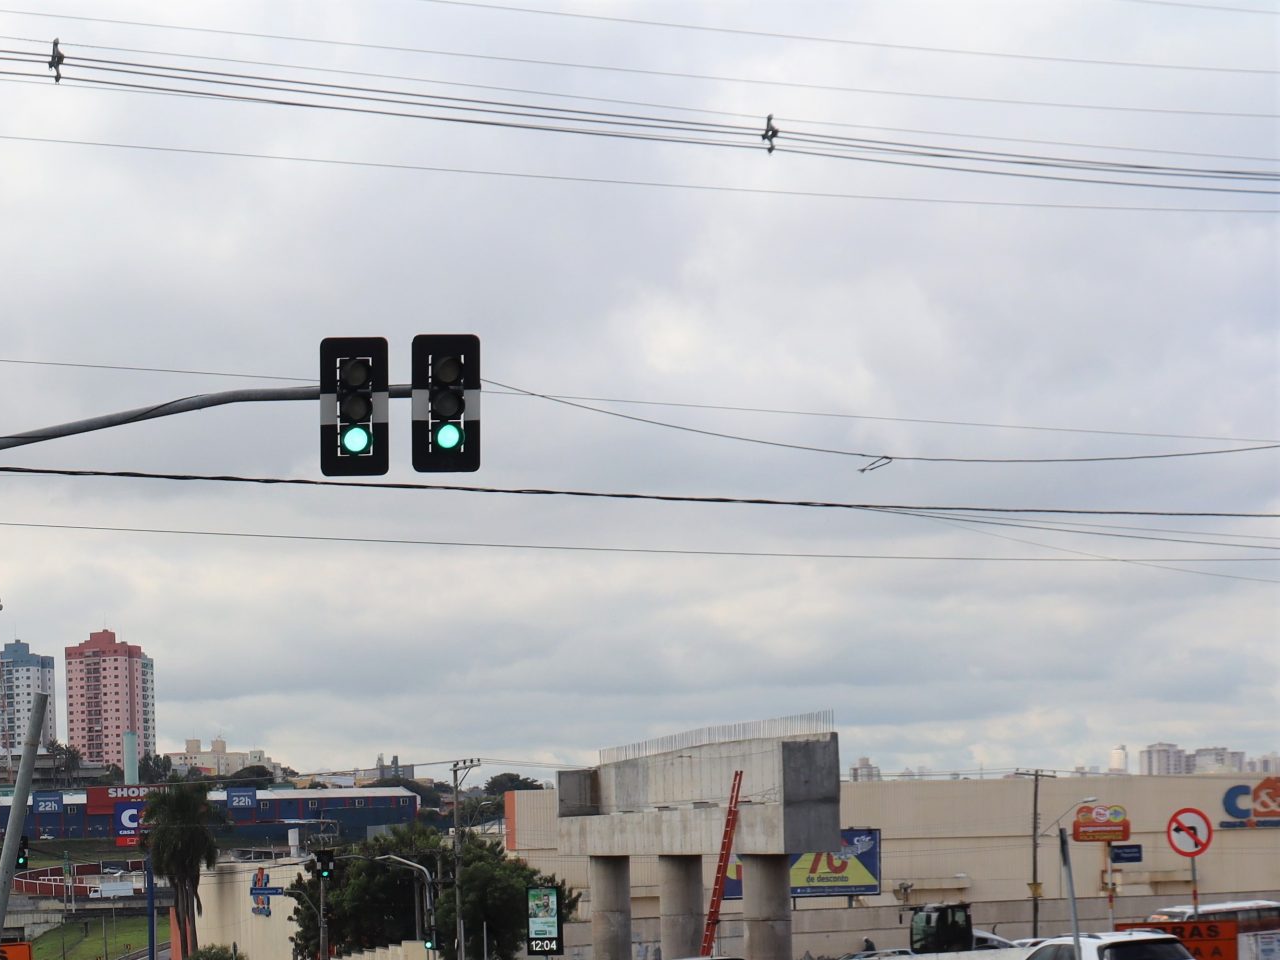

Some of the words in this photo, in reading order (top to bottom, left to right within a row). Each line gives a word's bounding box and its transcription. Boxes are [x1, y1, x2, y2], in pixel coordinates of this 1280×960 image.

[38, 800, 58, 811] 22h
[232, 796, 251, 806] 22h
[531, 940, 557, 951] 12:04
